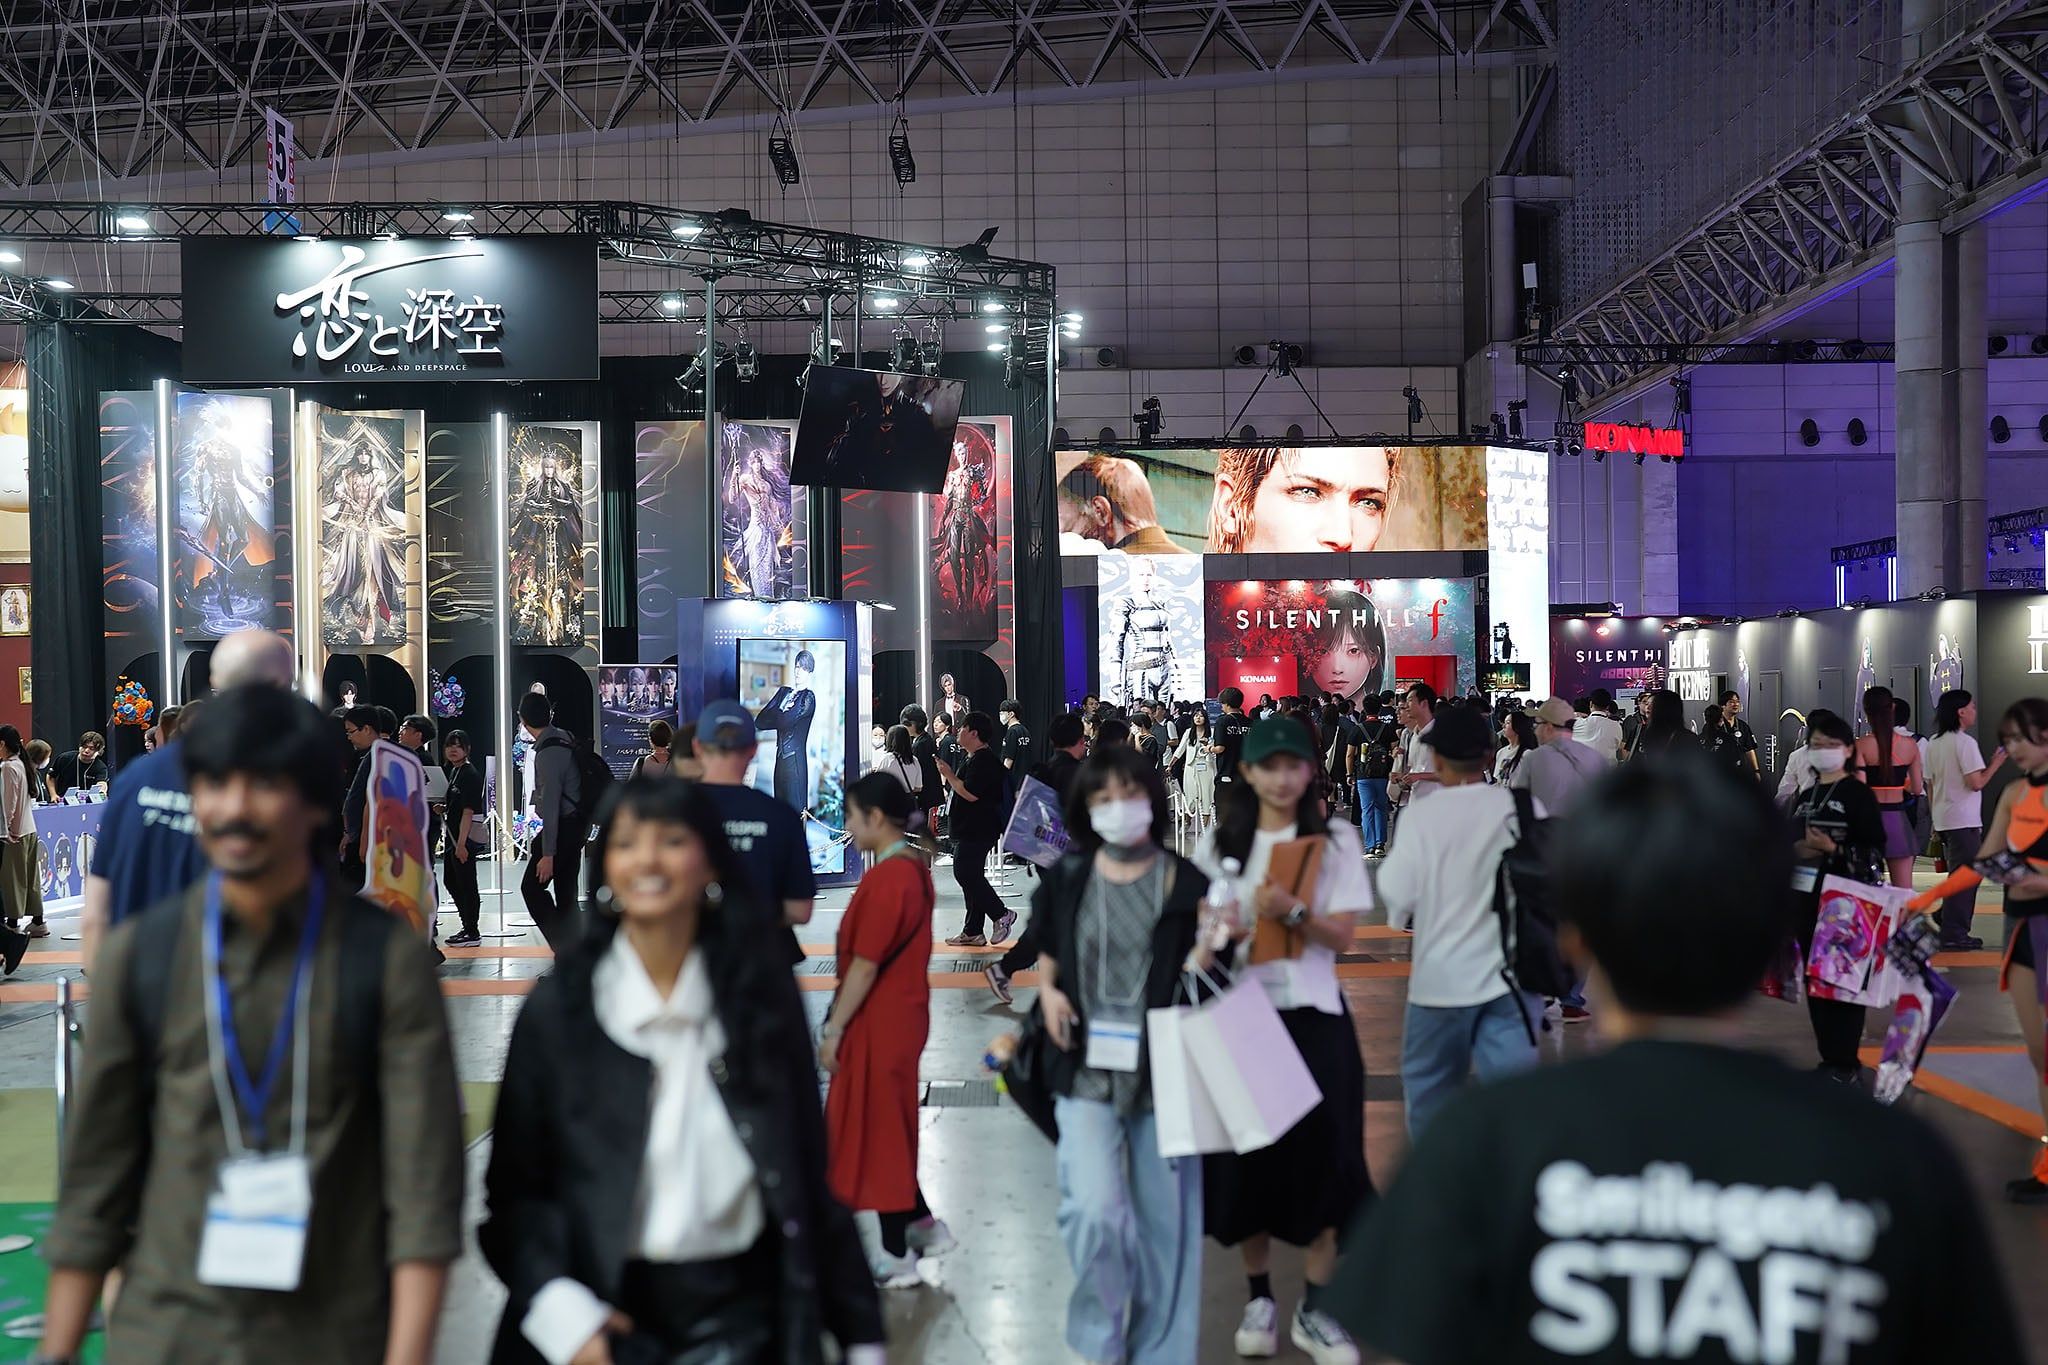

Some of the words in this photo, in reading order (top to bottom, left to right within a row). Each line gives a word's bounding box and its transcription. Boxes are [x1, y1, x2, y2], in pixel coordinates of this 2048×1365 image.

[276, 245, 502, 361] 恋と深空
[391, 364, 410, 372] AND
[415, 364, 468, 372] DEEPSPACE
[1584, 421, 1684, 456] KONAMI
[1236, 609, 1341, 629] SILENT
[1352, 608, 1415, 629] HILL
[1427, 598, 1448, 641] f
[1576, 650, 1639, 663] SILENT
[1644, 650, 1662, 661] HI
[1240, 675, 1276, 683] KONAMI
[1529, 1238, 1890, 1365] STAFF
